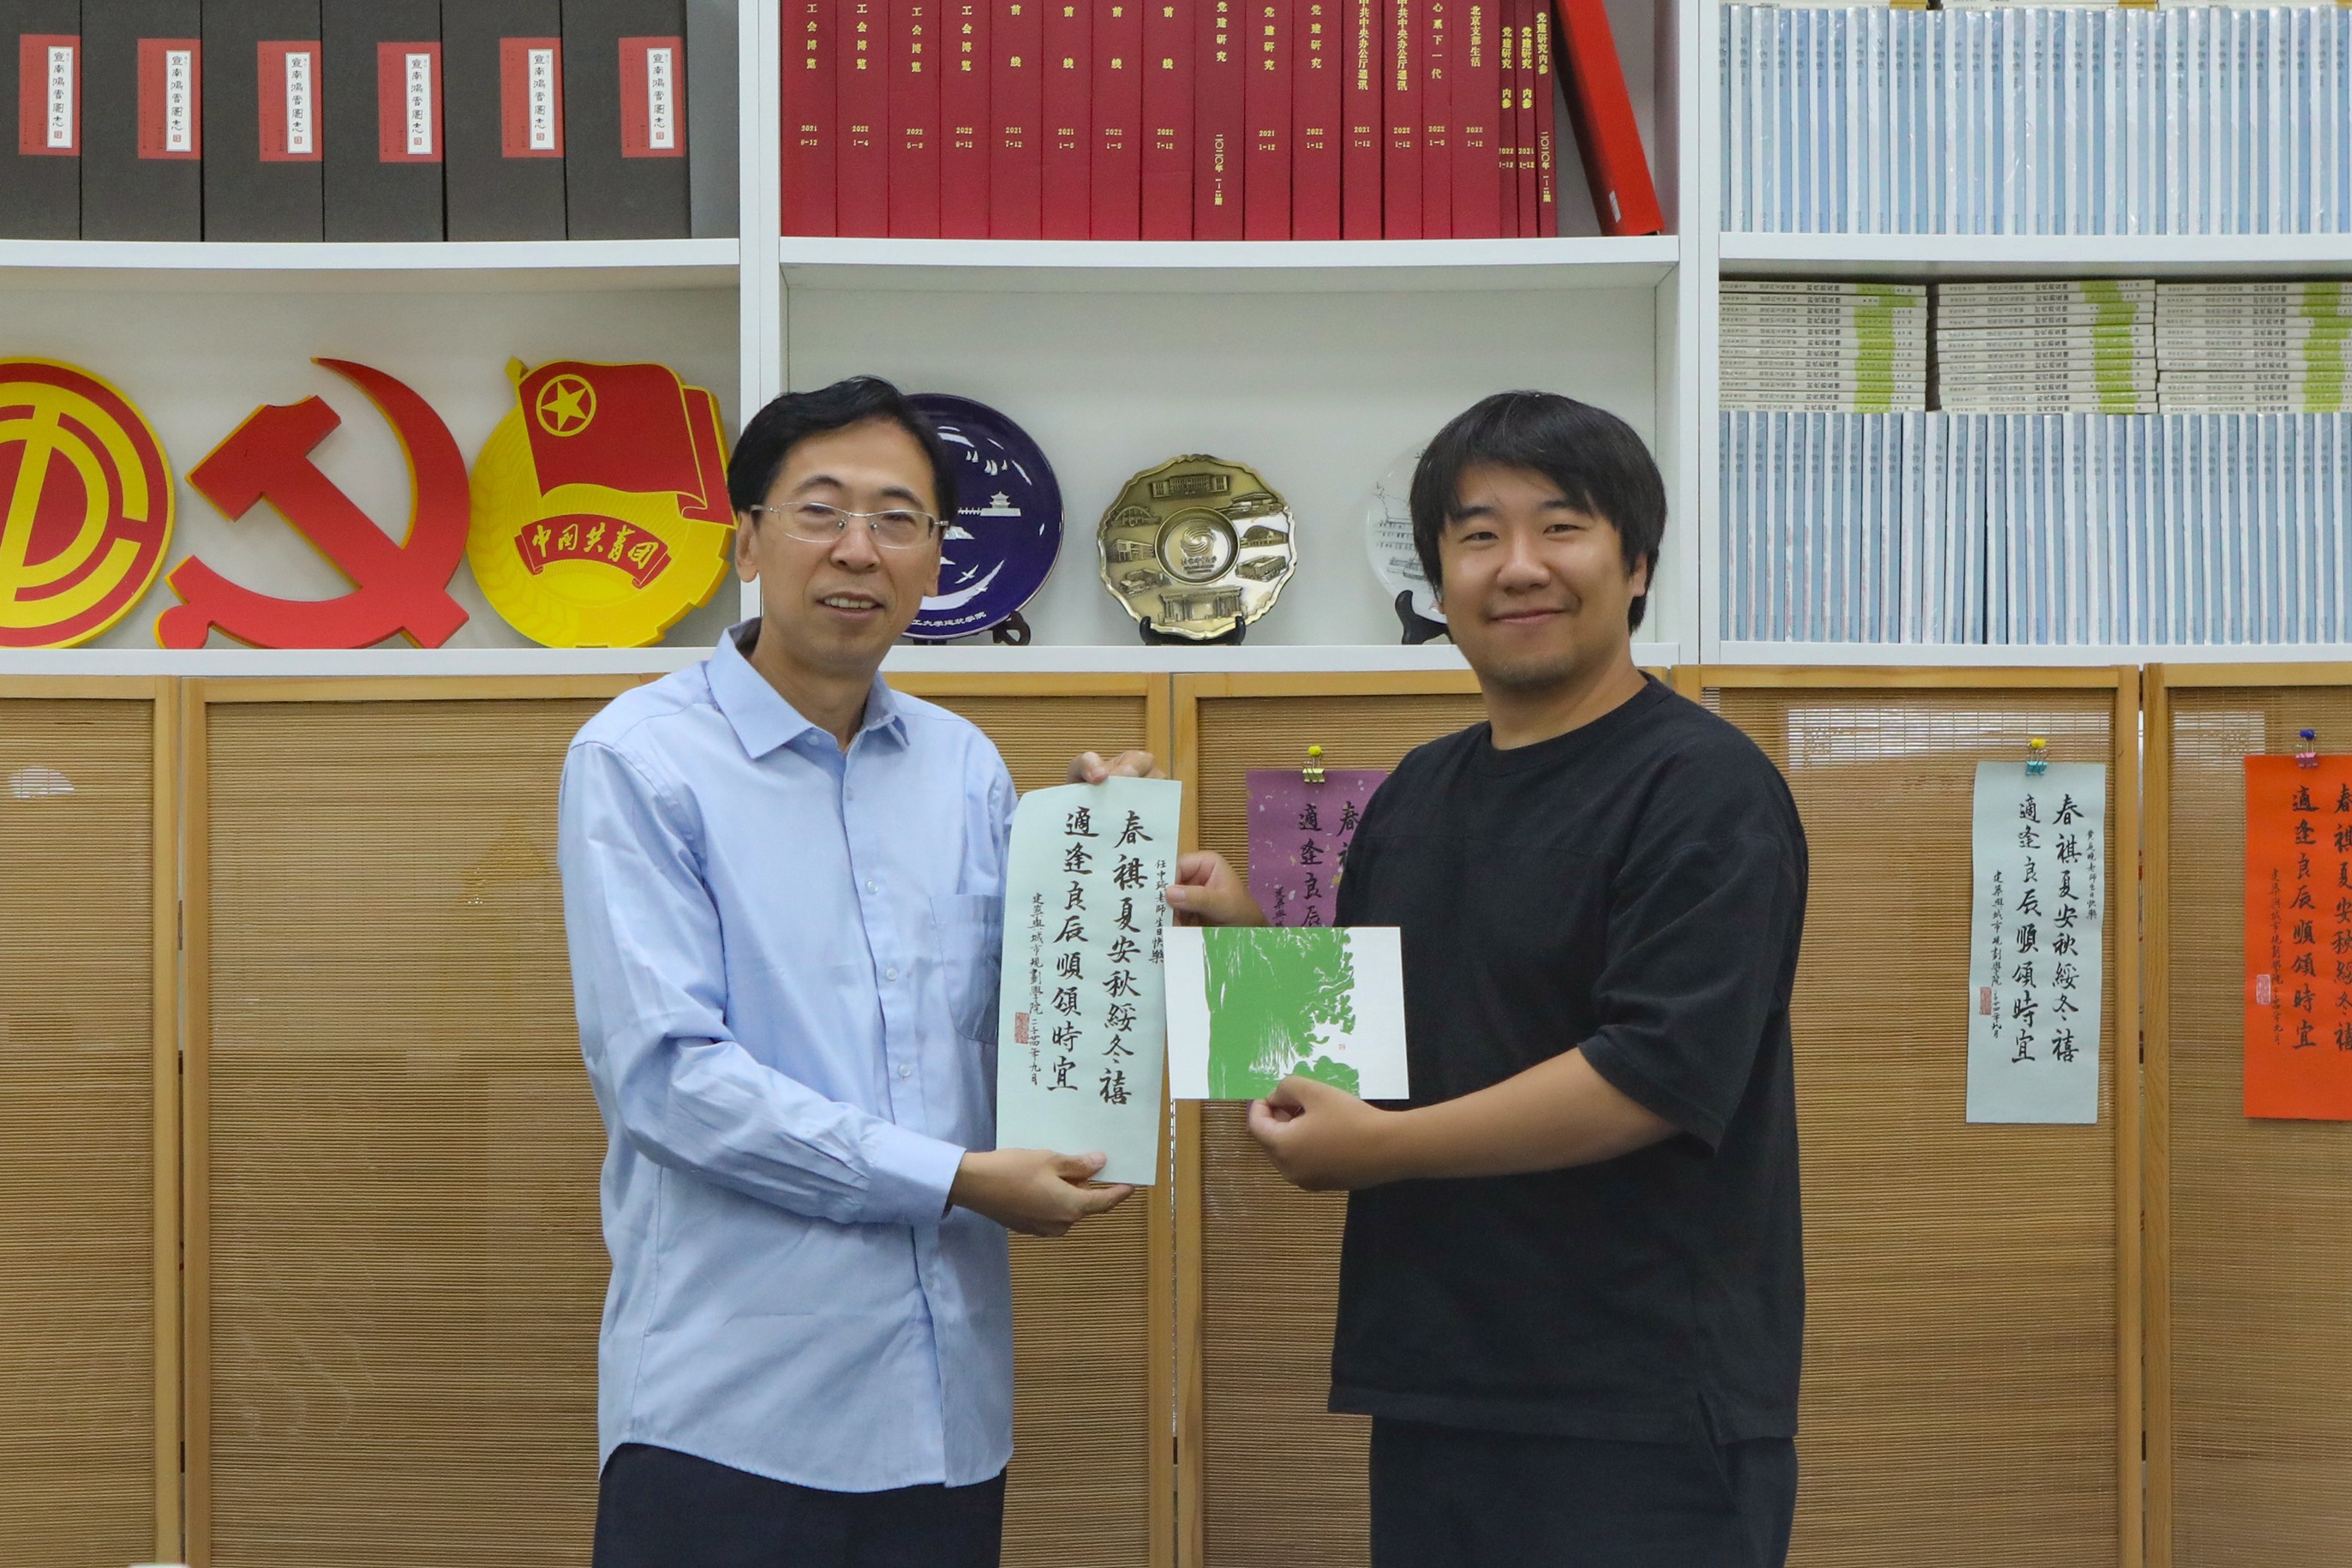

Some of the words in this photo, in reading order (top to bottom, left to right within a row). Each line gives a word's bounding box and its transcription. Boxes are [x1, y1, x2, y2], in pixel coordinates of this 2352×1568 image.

[807, 4, 817, 69] 工会博览
[857, 4, 868, 70] 工会博览
[912, 8, 923, 73] 工会博览
[961, 6, 973, 72] 工会博览
[1010, 4, 1021, 68] 前线
[1063, 6, 1074, 69] 前线
[1111, 6, 1122, 69] 前线
[1163, 6, 1174, 69] 前线
[1216, 2, 1227, 63] 党建研究
[1264, 7, 1275, 70] 党建研究
[1311, 4, 1322, 69] 党建研究
[1432, 3, 1444, 79] 心系下一代
[1470, 5, 1481, 67] 北京支部生活
[1502, 27, 1512, 69] 党建研究
[1521, 27, 1532, 69] 党建研究
[1536, 12, 1548, 75] 党建研究内参
[1502, 88, 1512, 109] 内参
[1522, 88, 1532, 109] 内参
[531, 522, 659, 570] 中国共青团
[1337, 801, 1360, 866] 春
